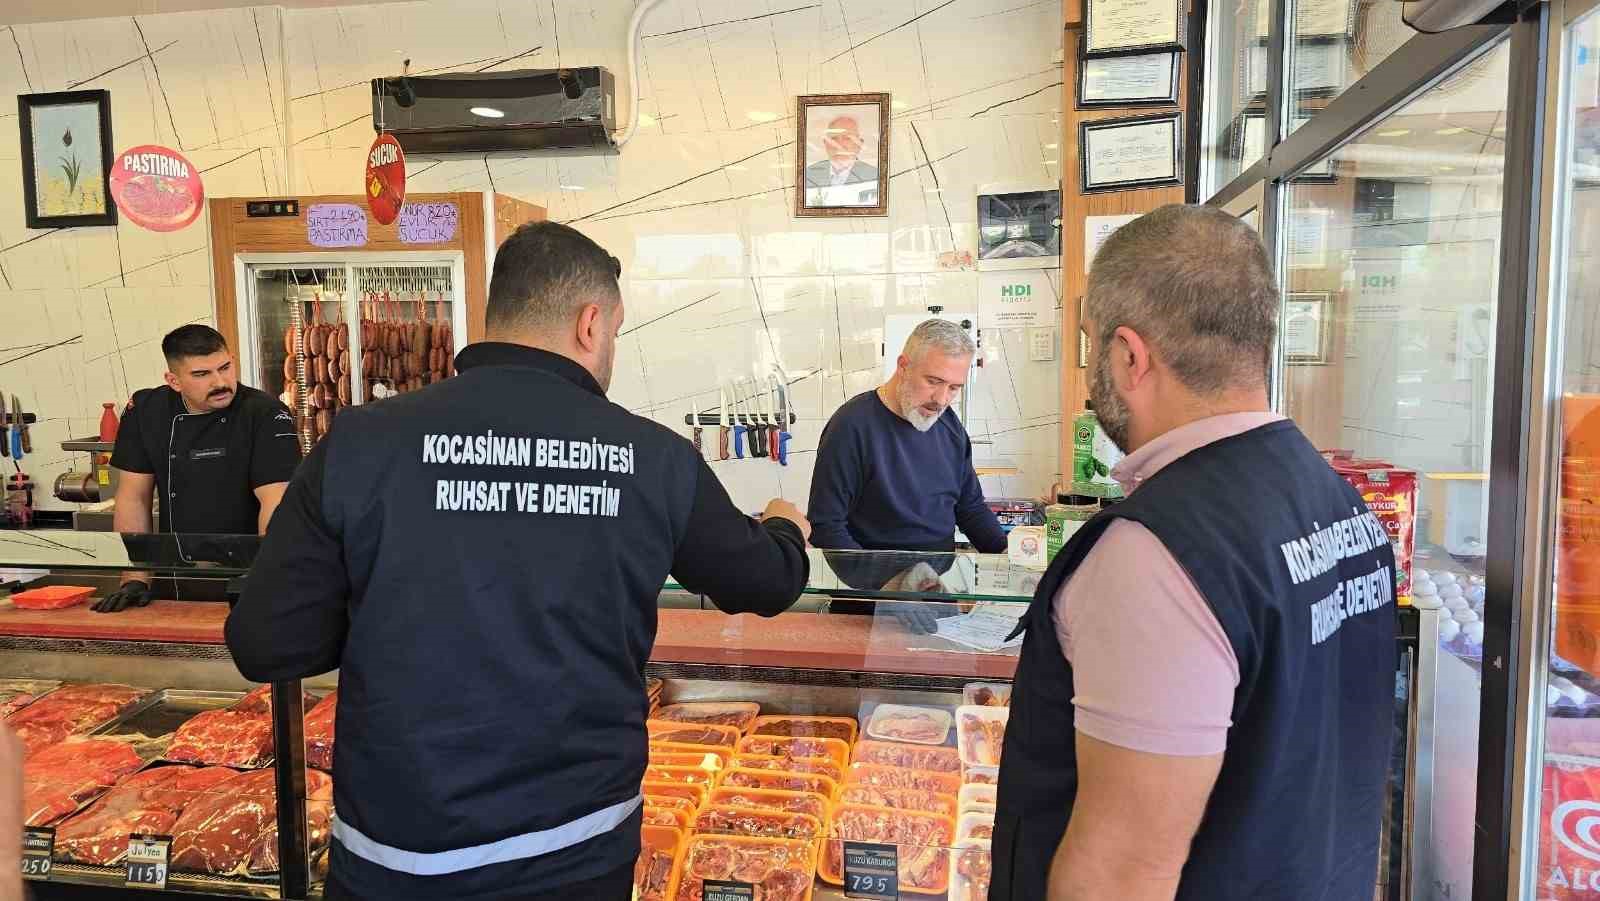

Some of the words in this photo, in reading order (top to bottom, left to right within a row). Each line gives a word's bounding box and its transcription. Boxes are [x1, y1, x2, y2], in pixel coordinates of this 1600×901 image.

[123, 153, 189, 178] PASTIRMA
[370, 143, 398, 169] SUCUK
[1001, 284, 1031, 297] HDI
[423, 429, 531, 467] KOCASİNAN
[535, 437, 634, 475] BELEDİYESİ
[436, 480, 511, 512] RUHSAT
[515, 482, 539, 513] VE
[543, 479, 620, 517] DENETİM
[1365, 502, 1397, 511] AYKUR
[128, 866, 164, 882] 1150
[852, 875, 888, 893] 795
